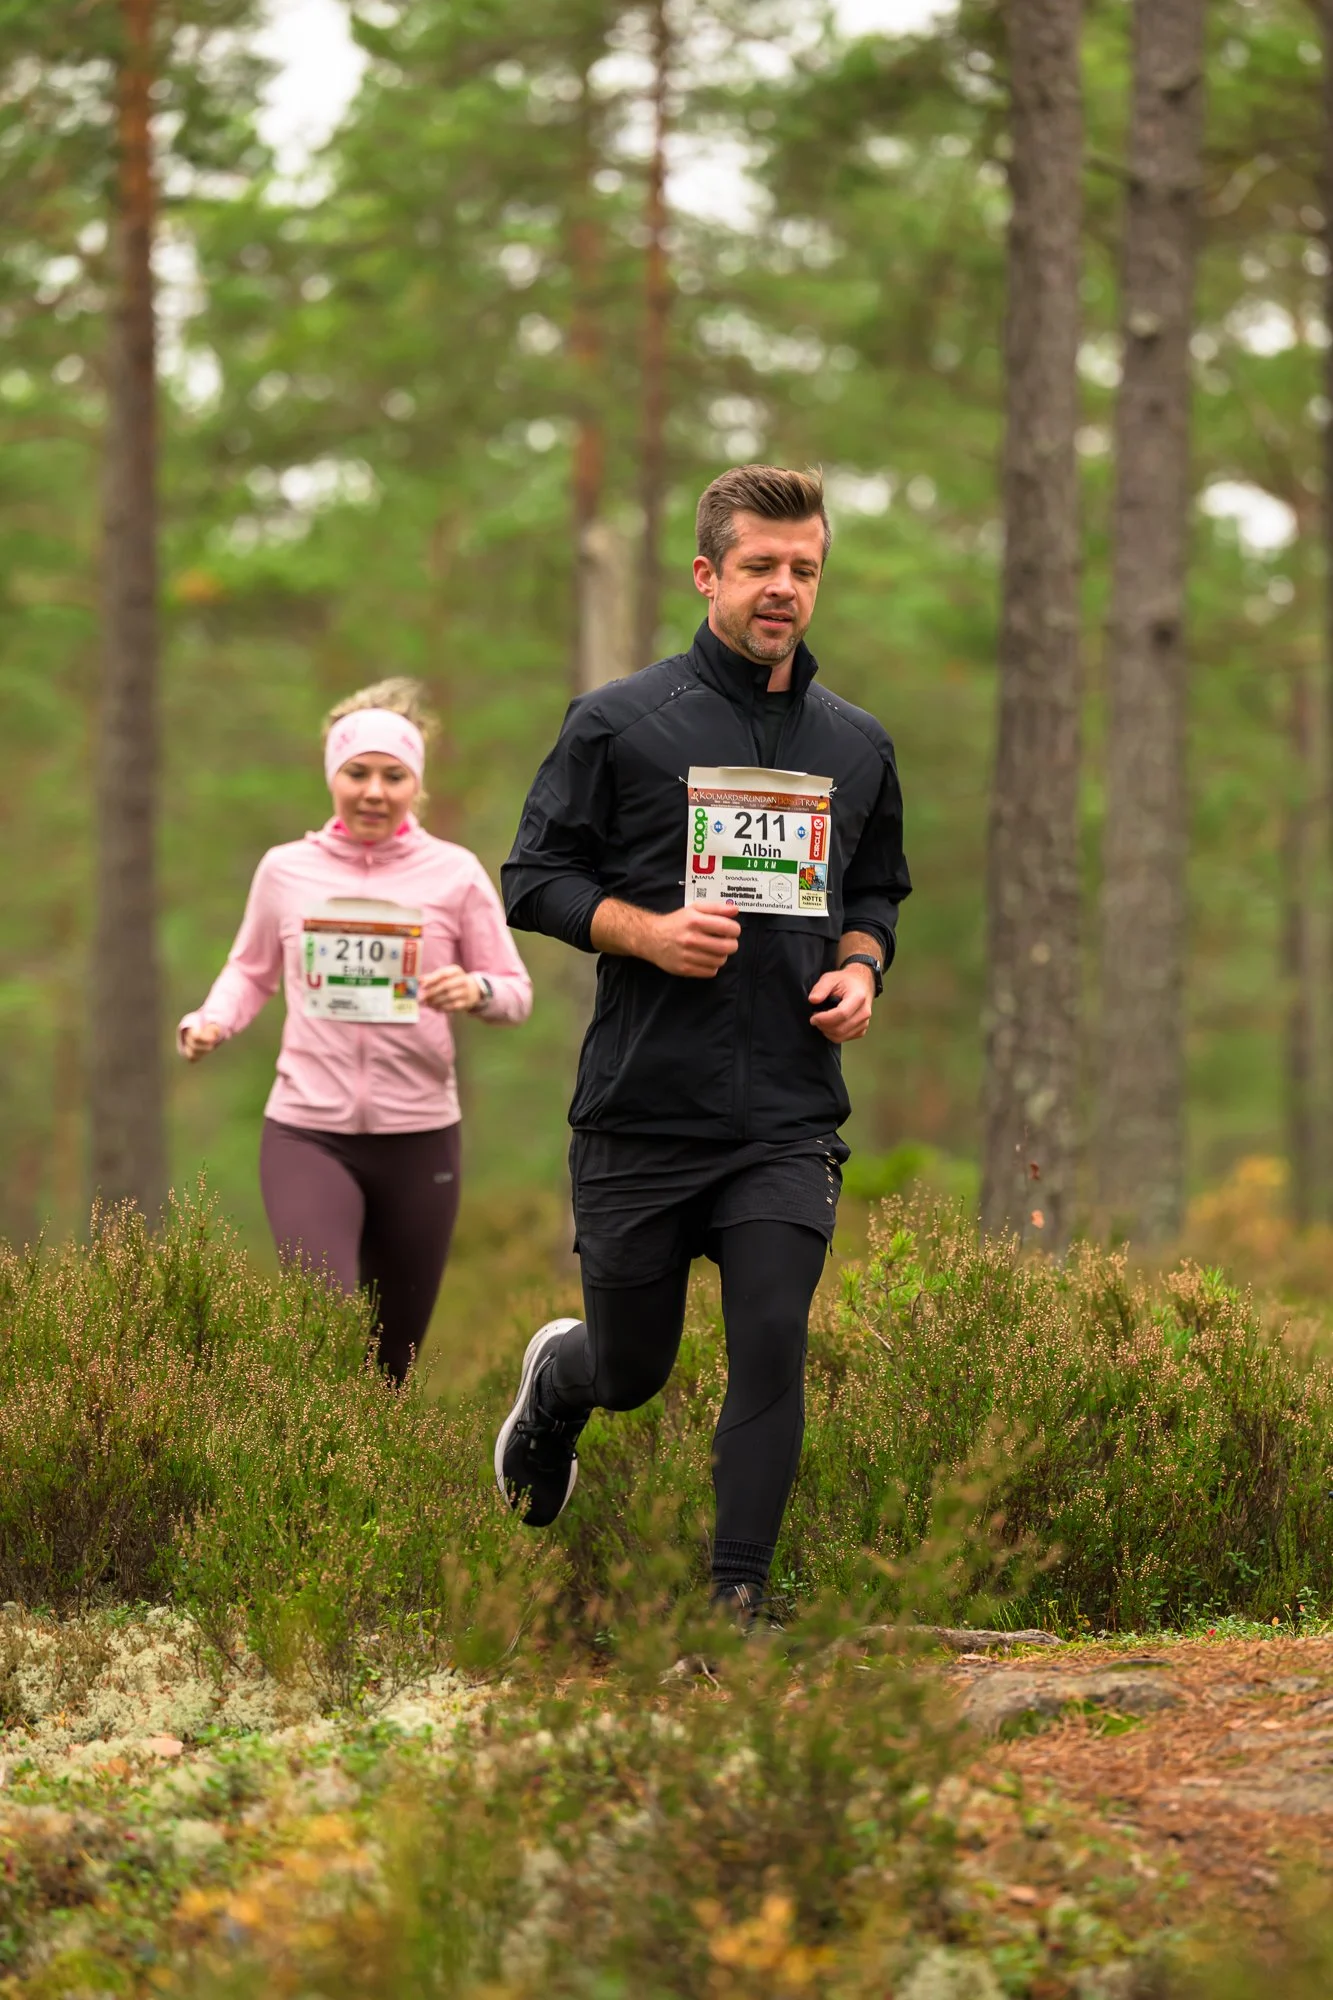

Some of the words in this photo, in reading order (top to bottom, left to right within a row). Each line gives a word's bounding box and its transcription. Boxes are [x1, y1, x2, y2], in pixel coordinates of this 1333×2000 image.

[694, 808, 708, 853] coop
[735, 812, 785, 841] 211
[742, 844, 781, 858] Albin
[813, 830, 822, 858] CIRCLE
[747, 860, 758, 868] 10
[764, 861, 777, 869] KM
[336, 939, 384, 962] 210
